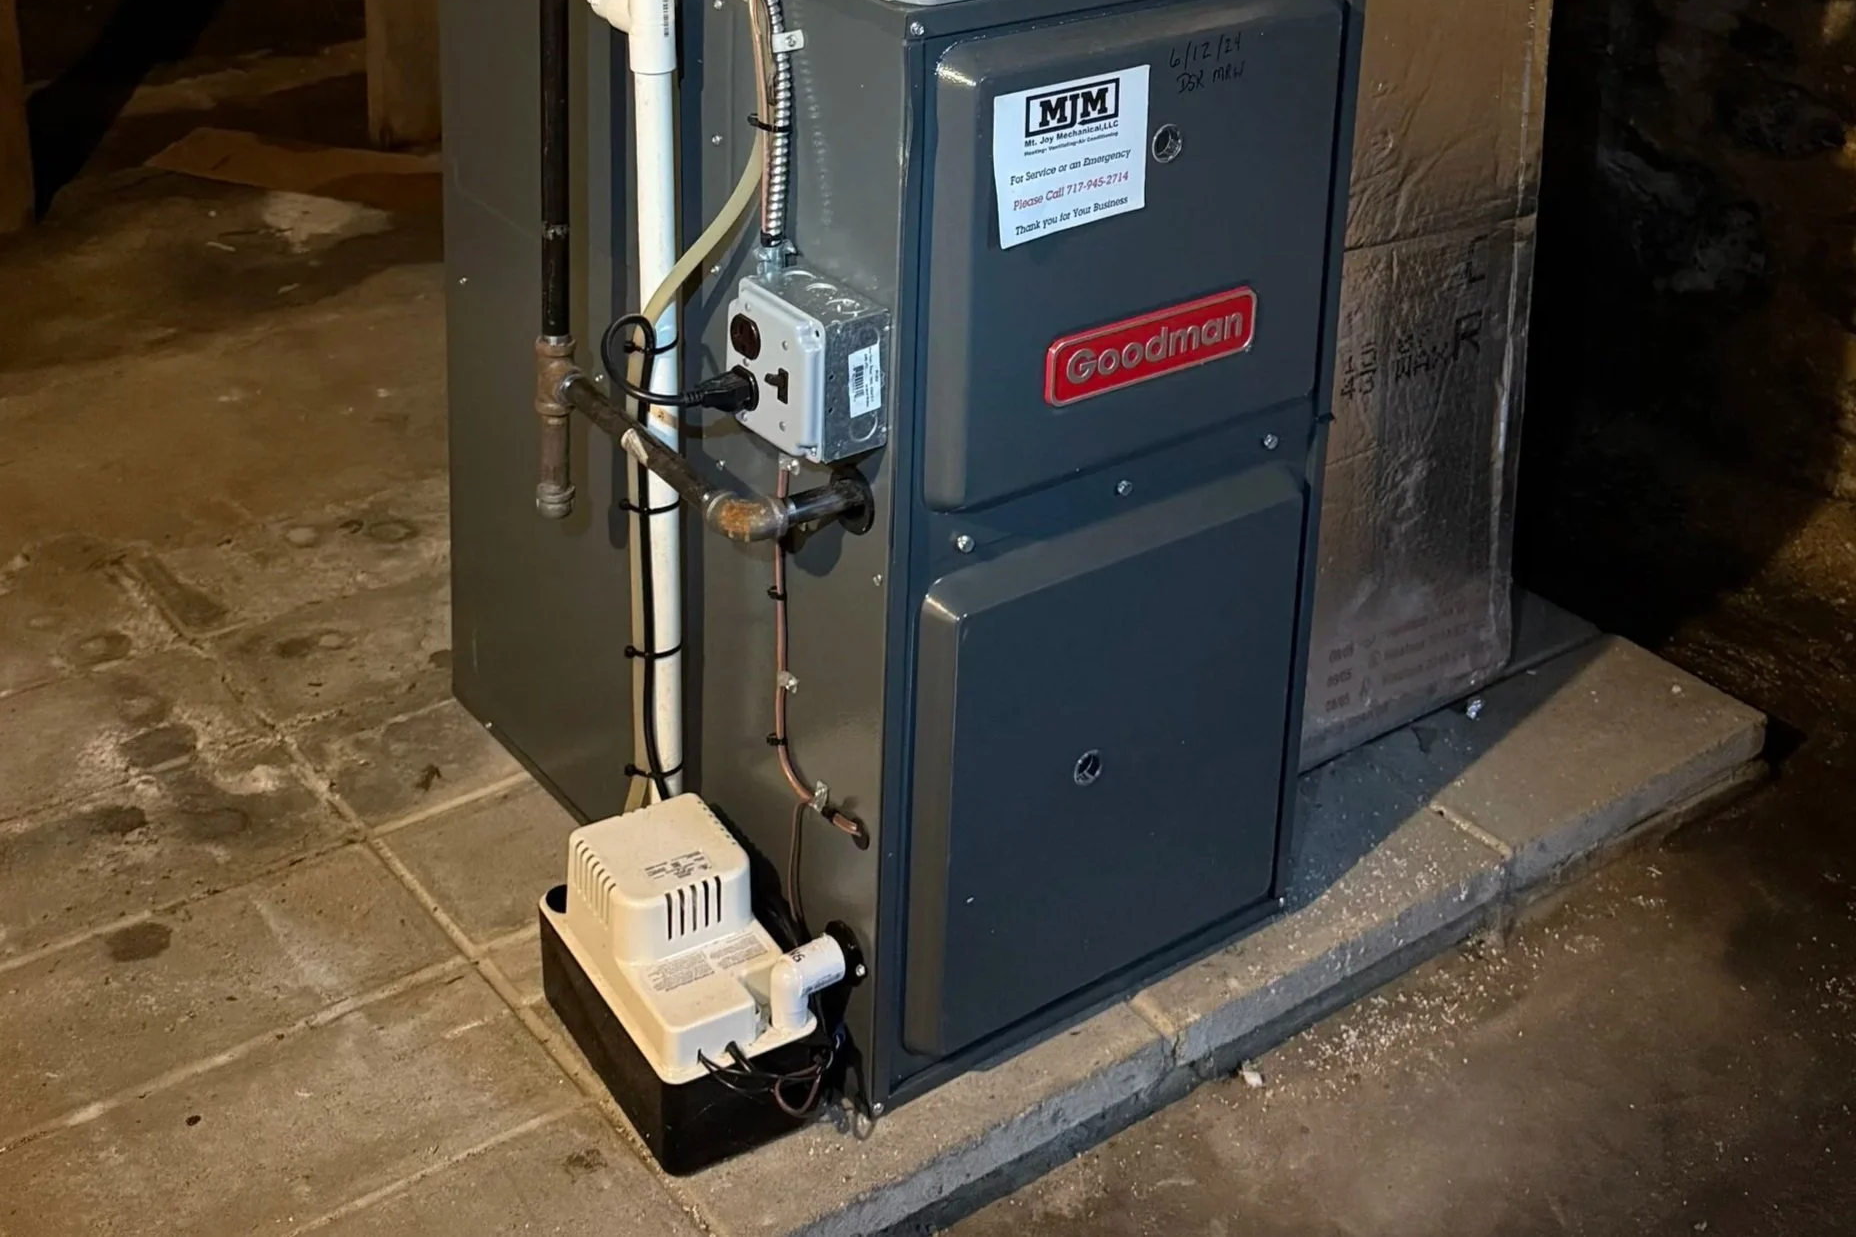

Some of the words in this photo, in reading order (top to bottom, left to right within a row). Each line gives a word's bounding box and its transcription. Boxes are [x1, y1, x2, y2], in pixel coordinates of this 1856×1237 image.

[1039, 87, 1109, 128] MJM
[1024, 139, 1038, 148] Mt.
[1040, 134, 1054, 145] Joy
[1010, 174, 1024, 186] For
[1025, 165, 1057, 182] Service
[1058, 162, 1068, 172] or
[1069, 158, 1082, 170] an
[1082, 149, 1131, 168] Emergency
[1013, 195, 1043, 211] Please
[1045, 187, 1065, 201] Call
[1066, 171, 1129, 196] 717-945-2714
[1015, 219, 1041, 236] Thank
[1042, 216, 1058, 230] you
[1059, 210, 1071, 223] for
[1072, 204, 1092, 219] Your
[1092, 195, 1129, 213] Business
[1066, 312, 1243, 384] Goodman
